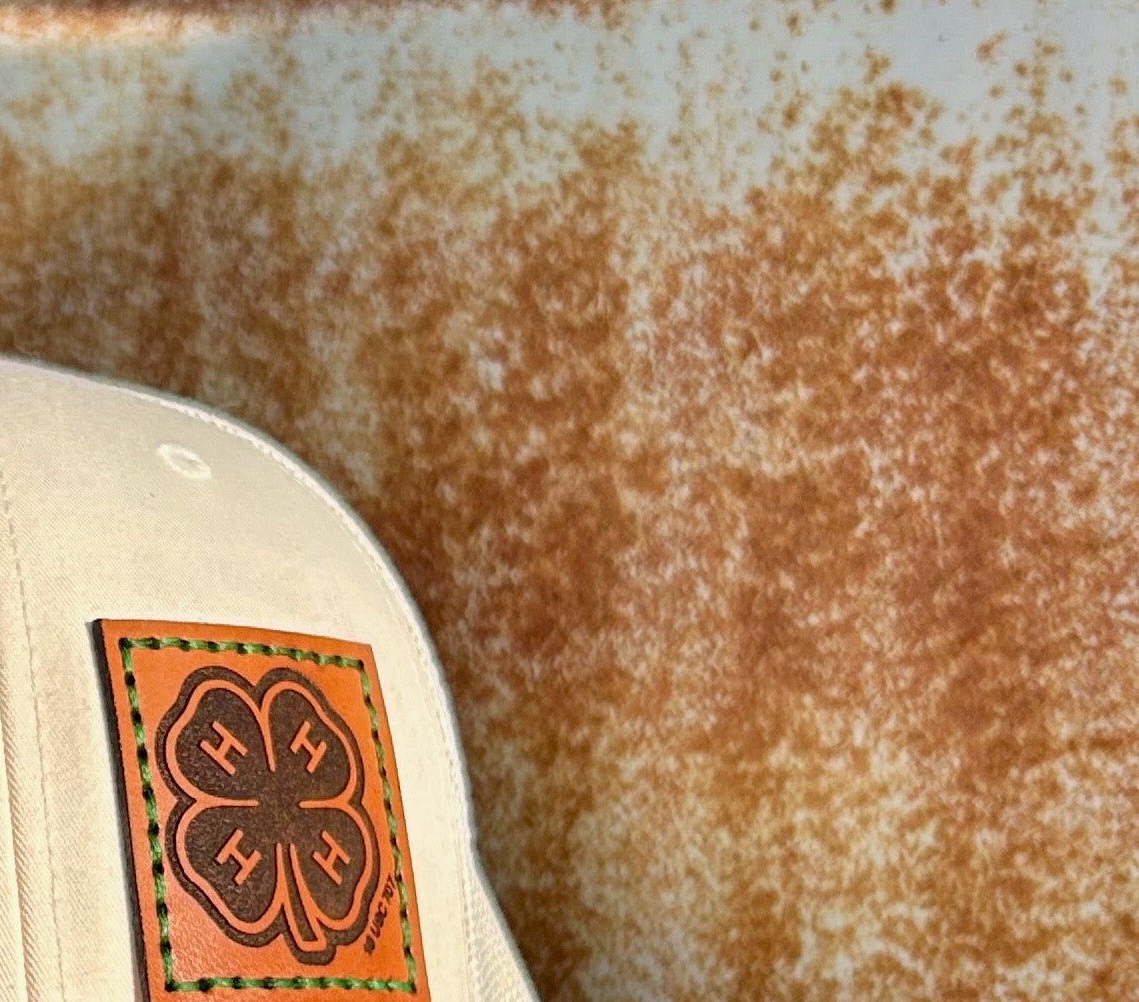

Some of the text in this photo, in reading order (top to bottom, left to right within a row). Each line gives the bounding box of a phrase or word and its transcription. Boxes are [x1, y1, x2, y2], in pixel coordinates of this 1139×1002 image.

[200, 720, 249, 776] H
[290, 720, 328, 774] H
[215, 829, 262, 886] H
[313, 830, 352, 886] H
